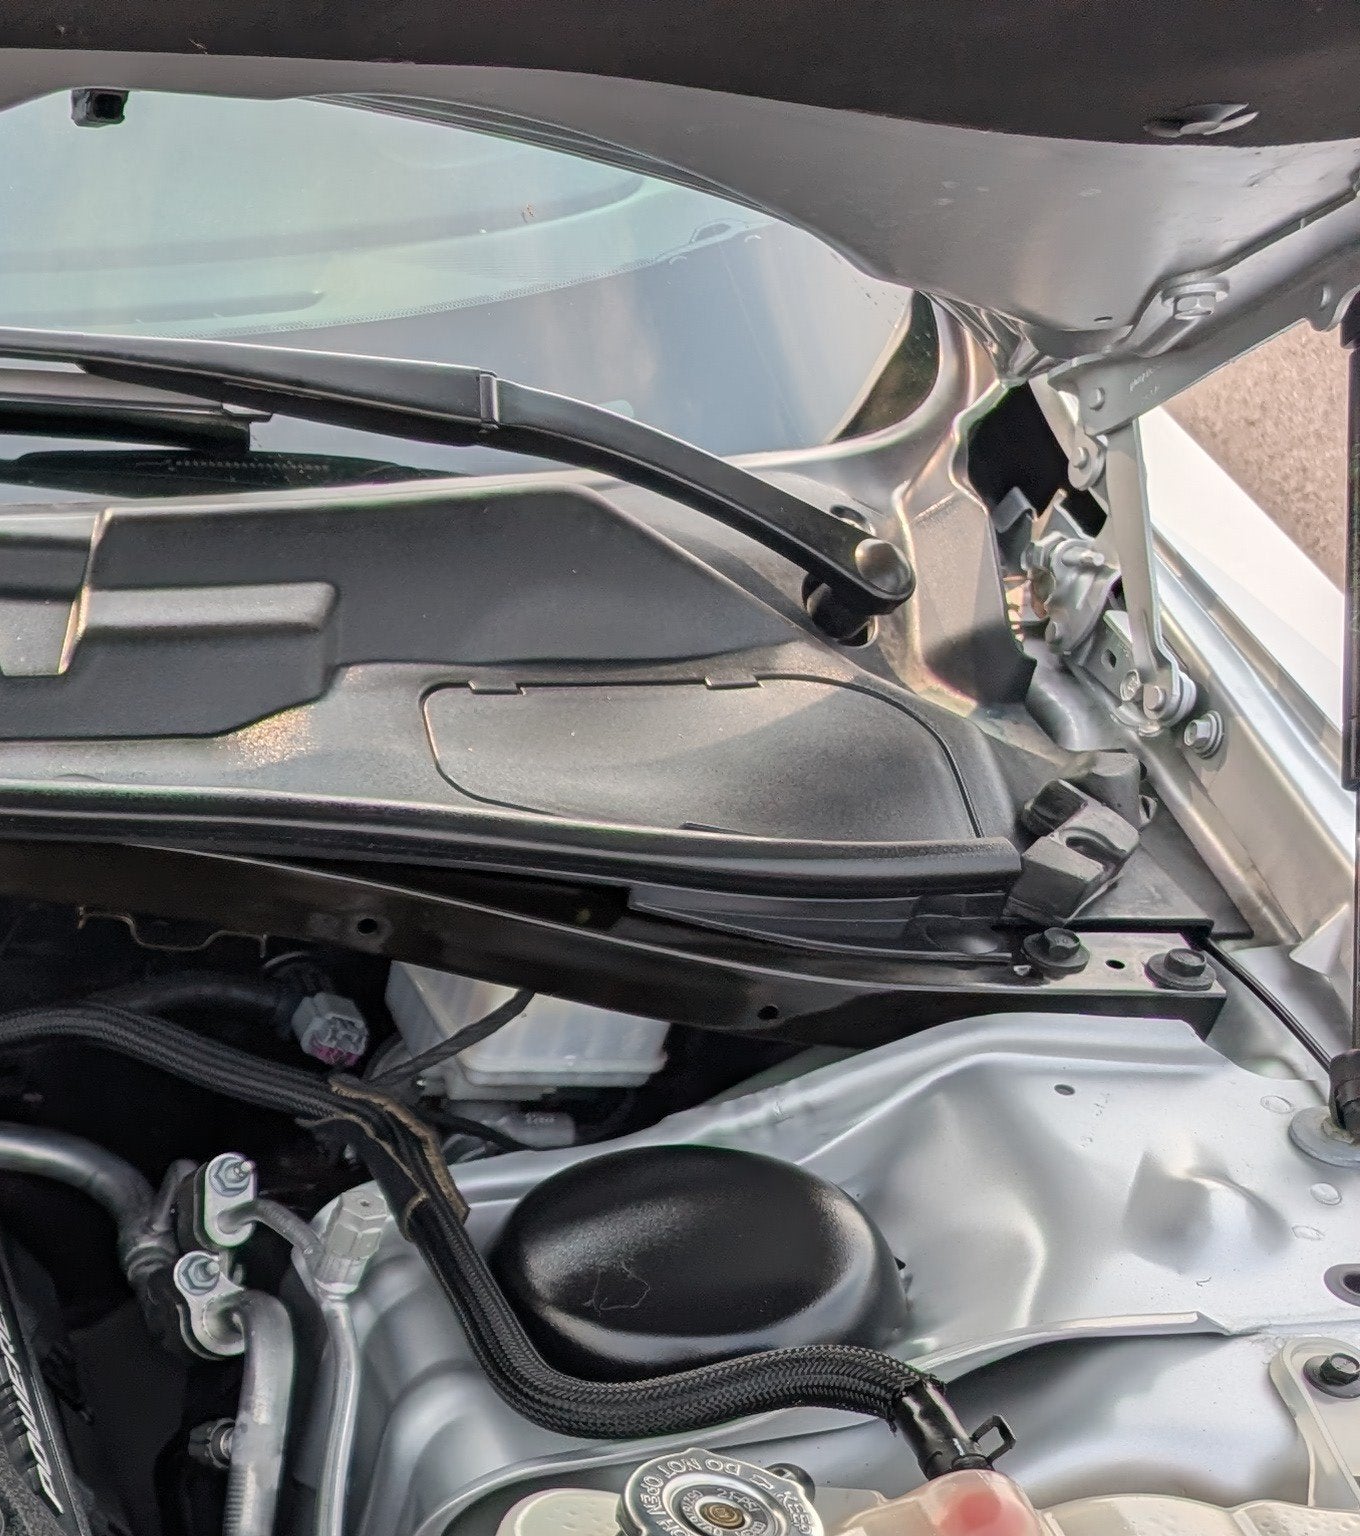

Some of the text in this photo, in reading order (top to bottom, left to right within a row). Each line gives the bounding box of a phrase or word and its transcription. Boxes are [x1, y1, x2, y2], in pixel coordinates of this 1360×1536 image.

[656, 1456, 703, 1479] NOT
[704, 1457, 742, 1477] DO
[639, 1474, 667, 1516] OPEN
